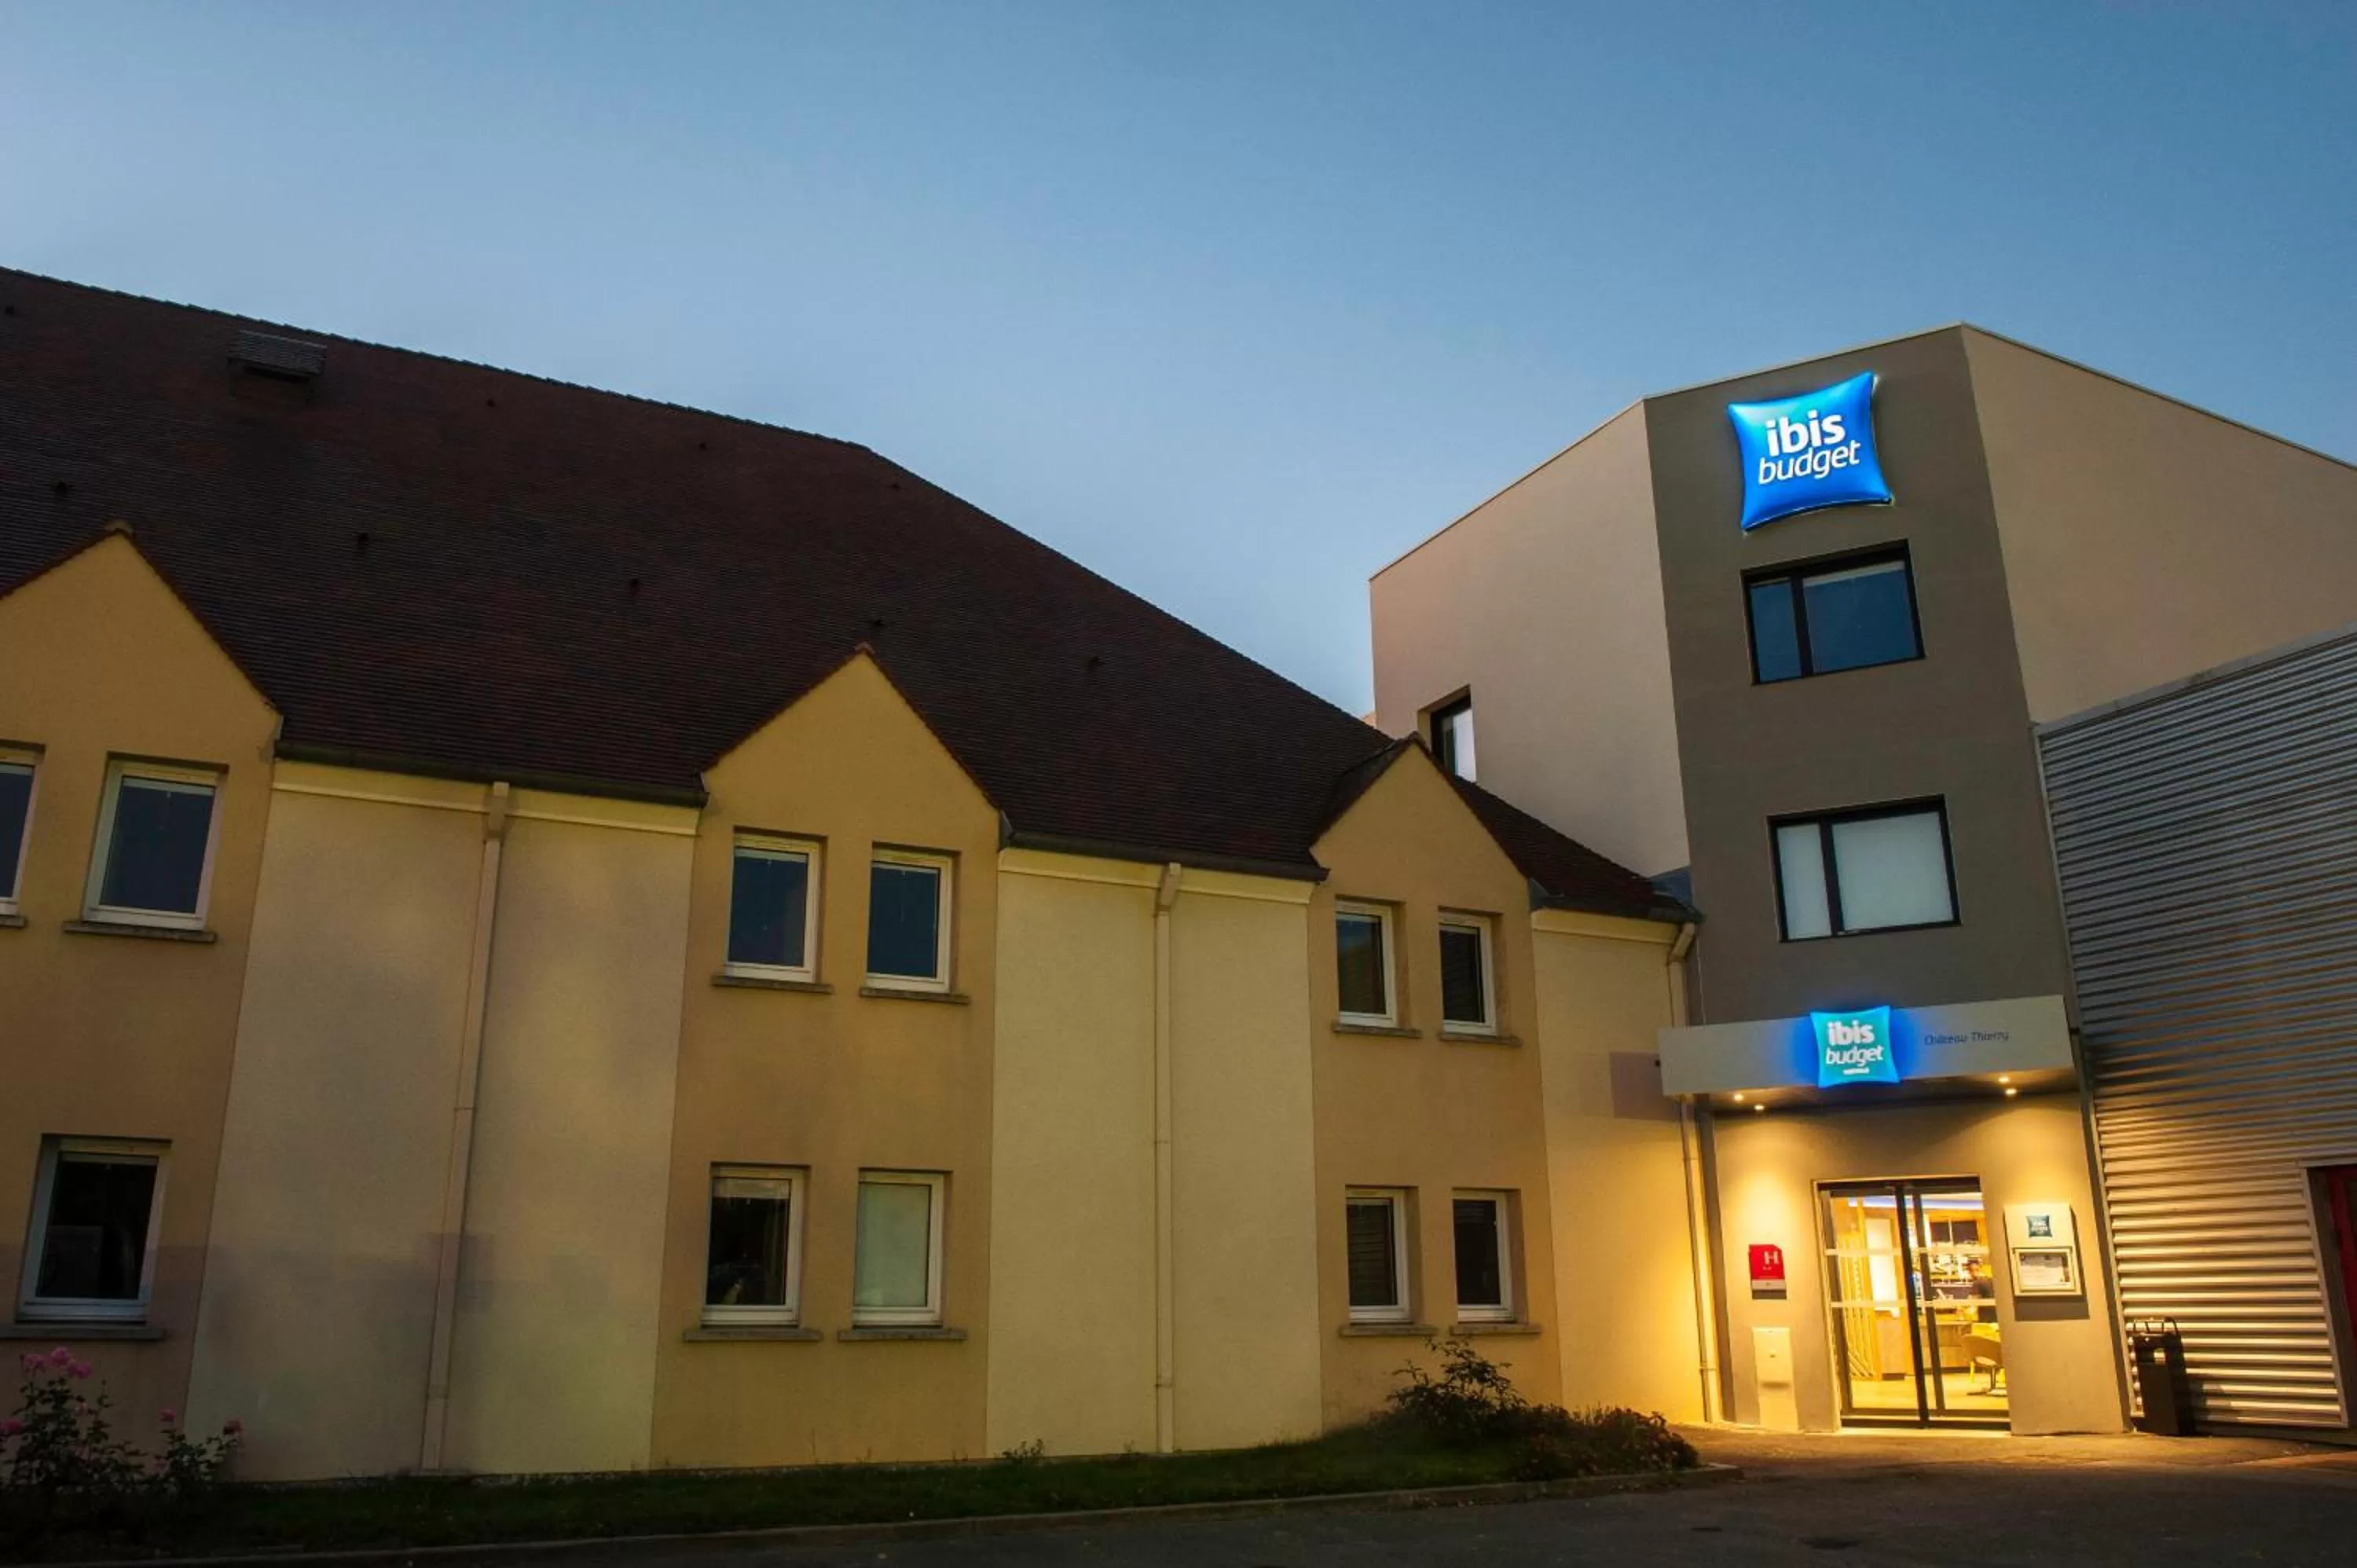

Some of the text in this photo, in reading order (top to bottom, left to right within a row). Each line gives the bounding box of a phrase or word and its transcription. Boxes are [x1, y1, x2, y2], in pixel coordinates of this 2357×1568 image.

[1766, 409, 1846, 456] ibis
[1758, 440, 1860, 485] budget
[1827, 1020, 1875, 1046] ibis
[1826, 1046, 1884, 1067] budget
